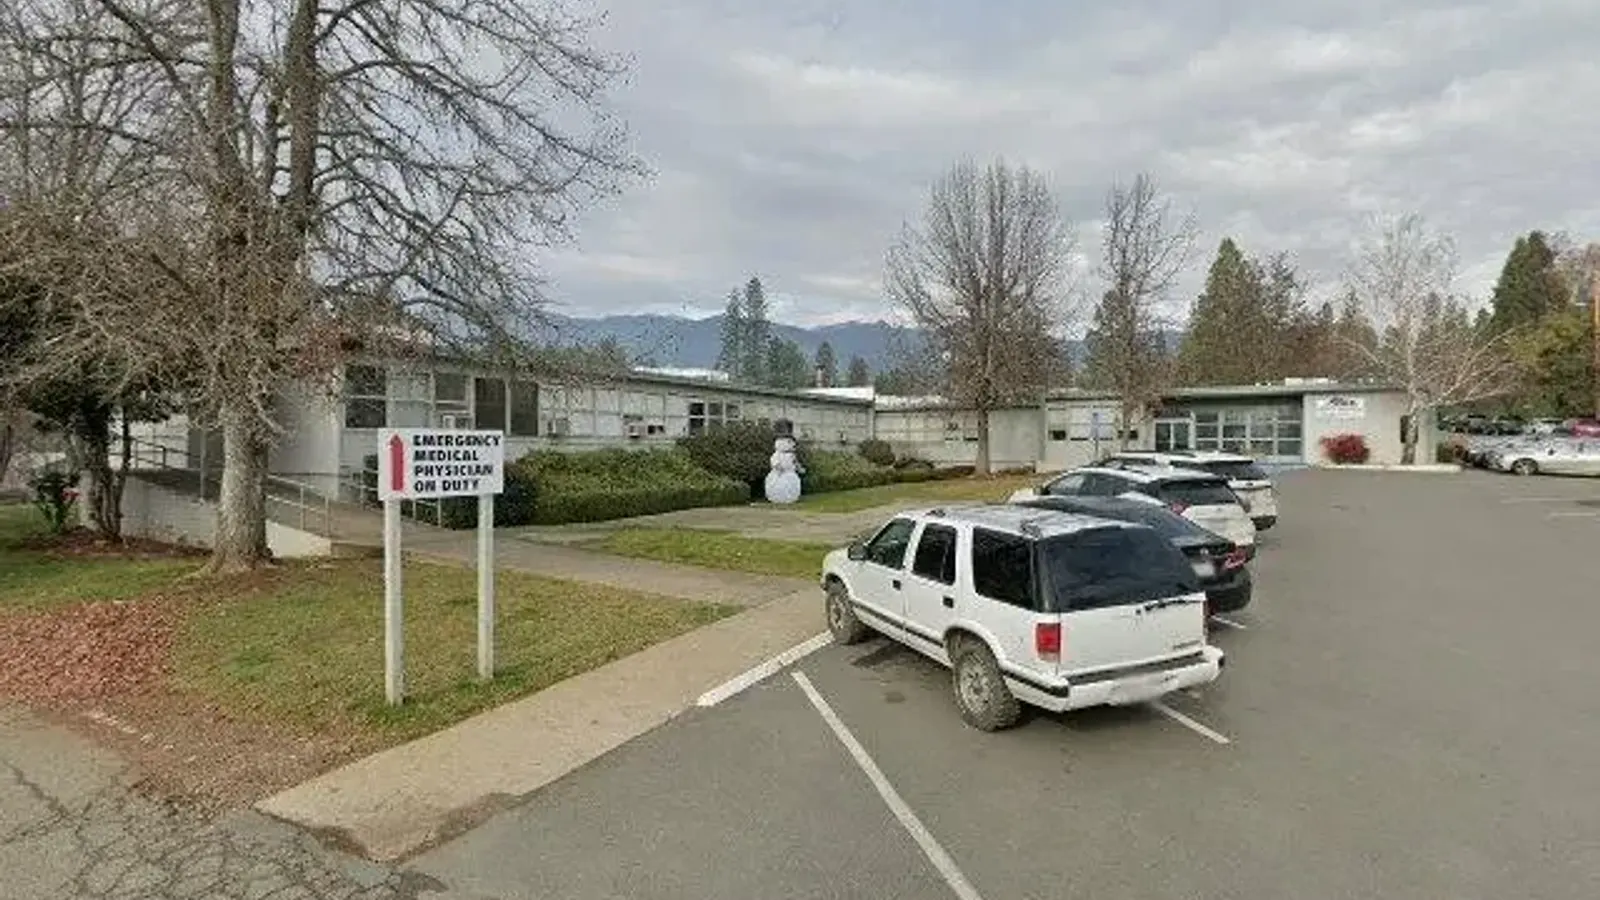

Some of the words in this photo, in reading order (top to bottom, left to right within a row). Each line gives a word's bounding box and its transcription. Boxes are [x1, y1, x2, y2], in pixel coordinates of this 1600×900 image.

[413, 434, 501, 446] EMERGENCY
[413, 450, 479, 461] MEDICAL
[414, 465, 493, 476] PHYSICIAN
[414, 480, 436, 492] ON
[442, 480, 479, 491] DUTY
